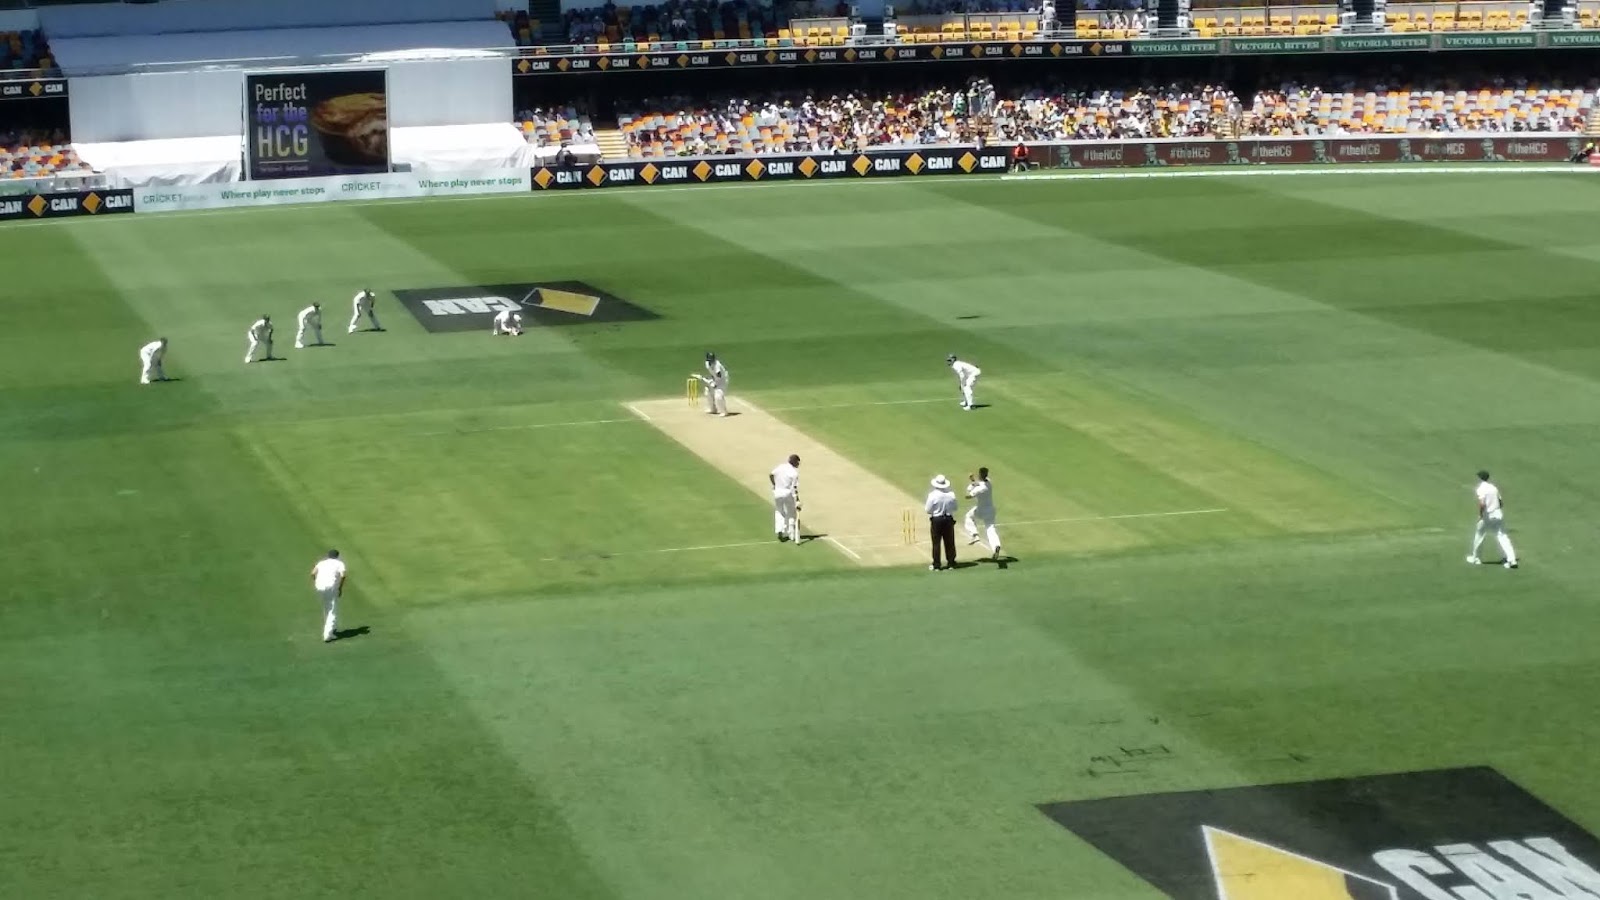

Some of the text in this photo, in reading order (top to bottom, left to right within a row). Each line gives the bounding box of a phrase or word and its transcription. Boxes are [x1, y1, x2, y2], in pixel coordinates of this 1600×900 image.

[1131, 42, 1216, 52] VICTORIA BITTER
[1234, 41, 1320, 50] VICTORIA BITTER
[1340, 37, 1427, 48] VICTORIA BITTER
[1446, 36, 1533, 46] VICTORIA BITTER
[859, 50, 876, 58] CAN
[899, 49, 916, 57] CAN
[946, 48, 963, 57] CAN
[986, 47, 1003, 55] CAN
[1025, 46, 1043, 55] CAN
[1065, 45, 1083, 54] CAN
[1105, 44, 1123, 53] CAN
[652, 57, 669, 66] CAN
[692, 56, 709, 64] CAN
[740, 53, 757, 62] CAN
[779, 52, 797, 61] CAN
[819, 51, 836, 60] CAN
[532, 61, 550, 70] CAN
[572, 60, 589, 69] CAN
[612, 58, 629, 67] CAN
[3, 86, 22, 95] CAN
[45, 83, 63, 93] CAN
[255, 83, 307, 101] Perfect
[256, 101, 308, 122] for the
[258, 124, 309, 158] HCG
[1083, 147, 1123, 161] #theHCG
[1170, 146, 1211, 159] #theHCG
[1252, 144, 1292, 157] #theHCG
[1340, 143, 1380, 156] #theHCG
[1507, 142, 1548, 155] #theHCG
[820, 160, 846, 173] CAN
[875, 159, 900, 171] CAN
[928, 157, 953, 169] CAN
[980, 156, 1006, 168] CAN
[609, 168, 635, 181] CAN
[662, 166, 688, 179] CAN
[715, 164, 741, 176] CAN
[768, 162, 793, 175] CAN
[556, 170, 582, 183] CAN
[418, 177, 522, 189] Where play never stops
[221, 186, 325, 200] Where play never stops
[51, 198, 77, 210] CAN
[106, 195, 132, 207] CAN
[421, 297, 522, 315] CAN
